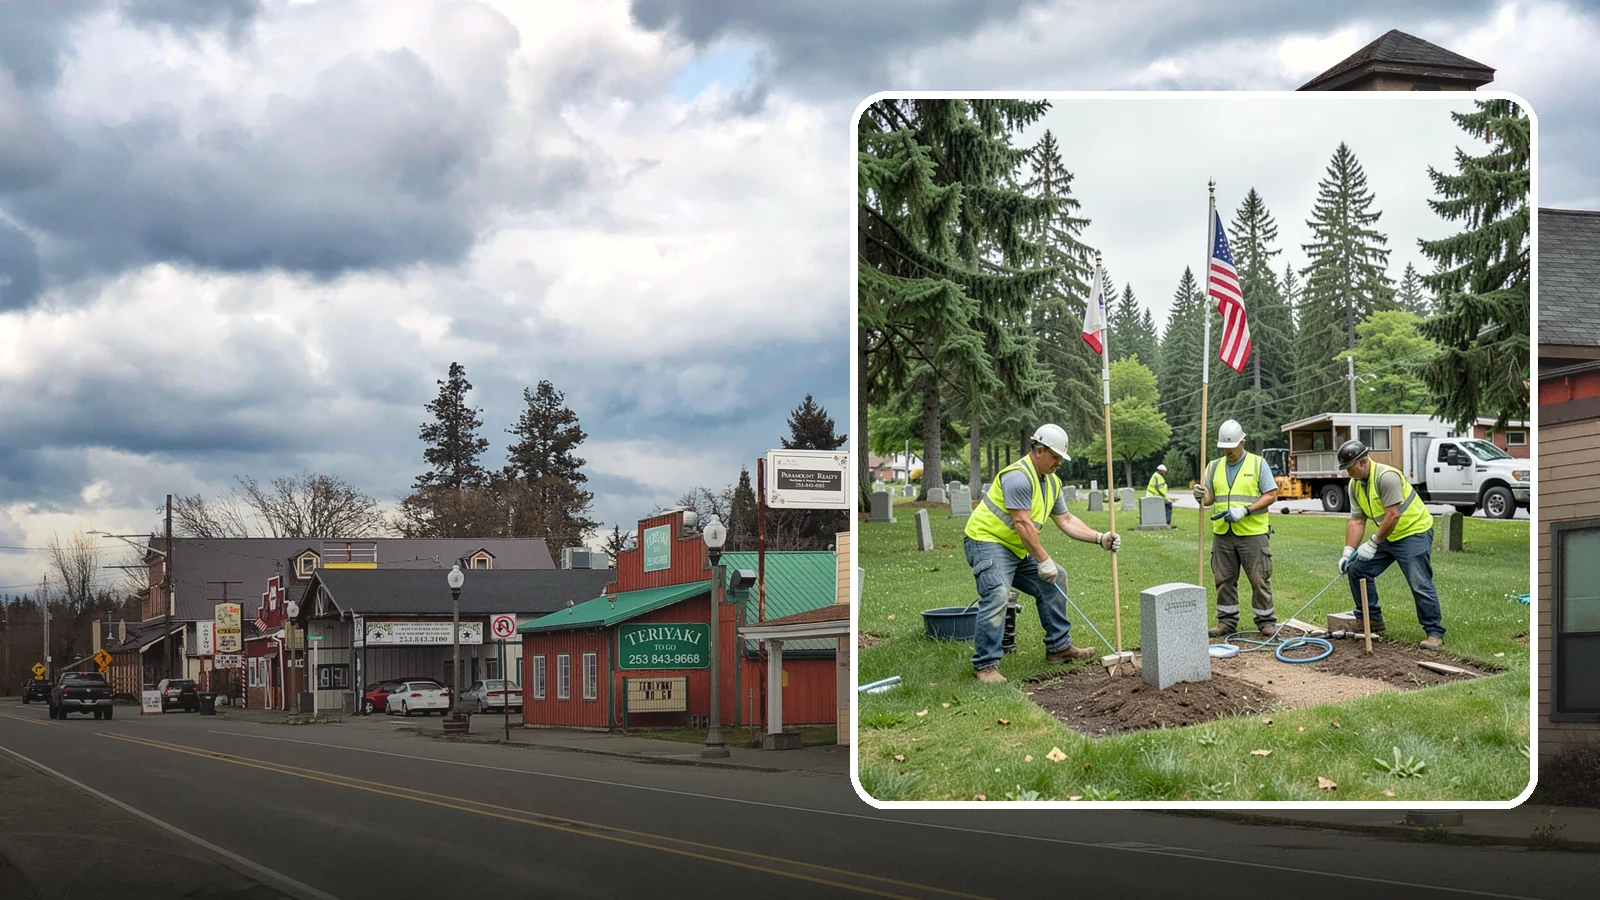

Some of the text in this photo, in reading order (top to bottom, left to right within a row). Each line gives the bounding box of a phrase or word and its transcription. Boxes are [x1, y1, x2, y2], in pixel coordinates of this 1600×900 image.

[625, 627, 702, 646] TERIYAKI
[629, 654, 700, 665] 253 843-9668
